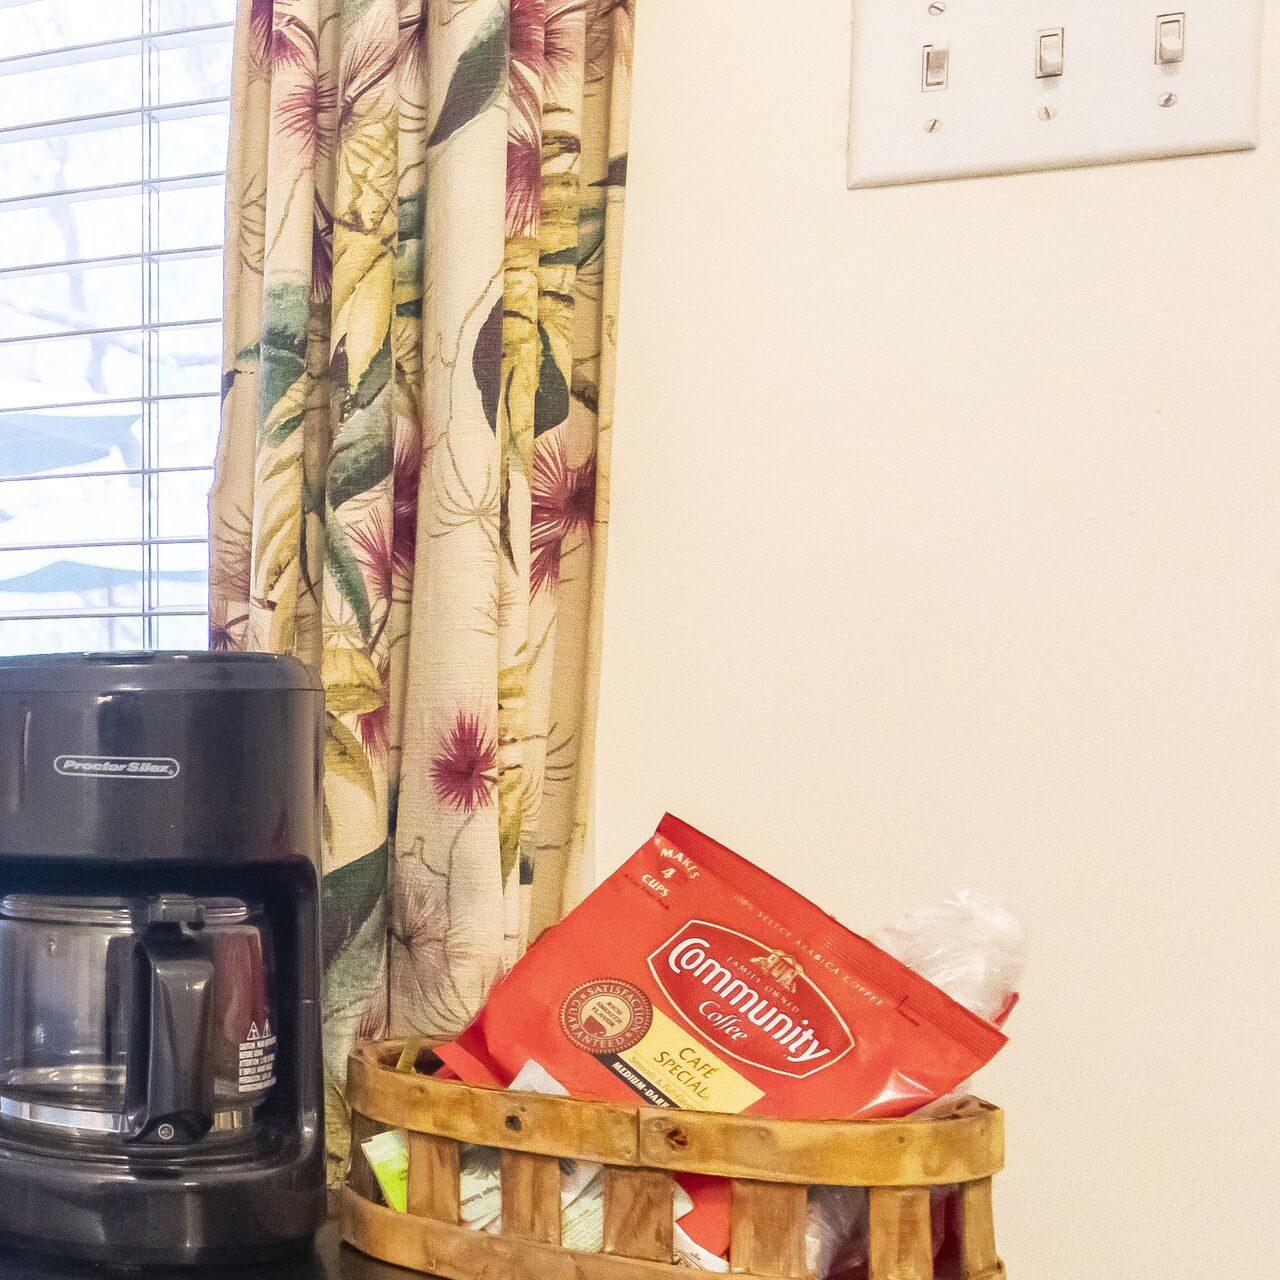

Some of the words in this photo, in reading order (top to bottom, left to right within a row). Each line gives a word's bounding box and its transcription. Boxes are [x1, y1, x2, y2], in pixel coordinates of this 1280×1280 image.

[641, 874, 670, 897] CUPS
[660, 848, 700, 880] MAKES
[661, 867, 677, 879] 4
[757, 911, 793, 939] SELECT
[842, 975, 886, 1007] COFFEE
[587, 984, 644, 1033] SATISFACTION
[668, 937, 831, 1063] Community
[698, 1000, 749, 1041] Coffee
[567, 999, 624, 1048] GUARANTEED
[611, 1061, 671, 1107] MEDIUM-DARK
[653, 1051, 709, 1098] SPECIAL
[678, 1047, 719, 1079] CAFÉ
